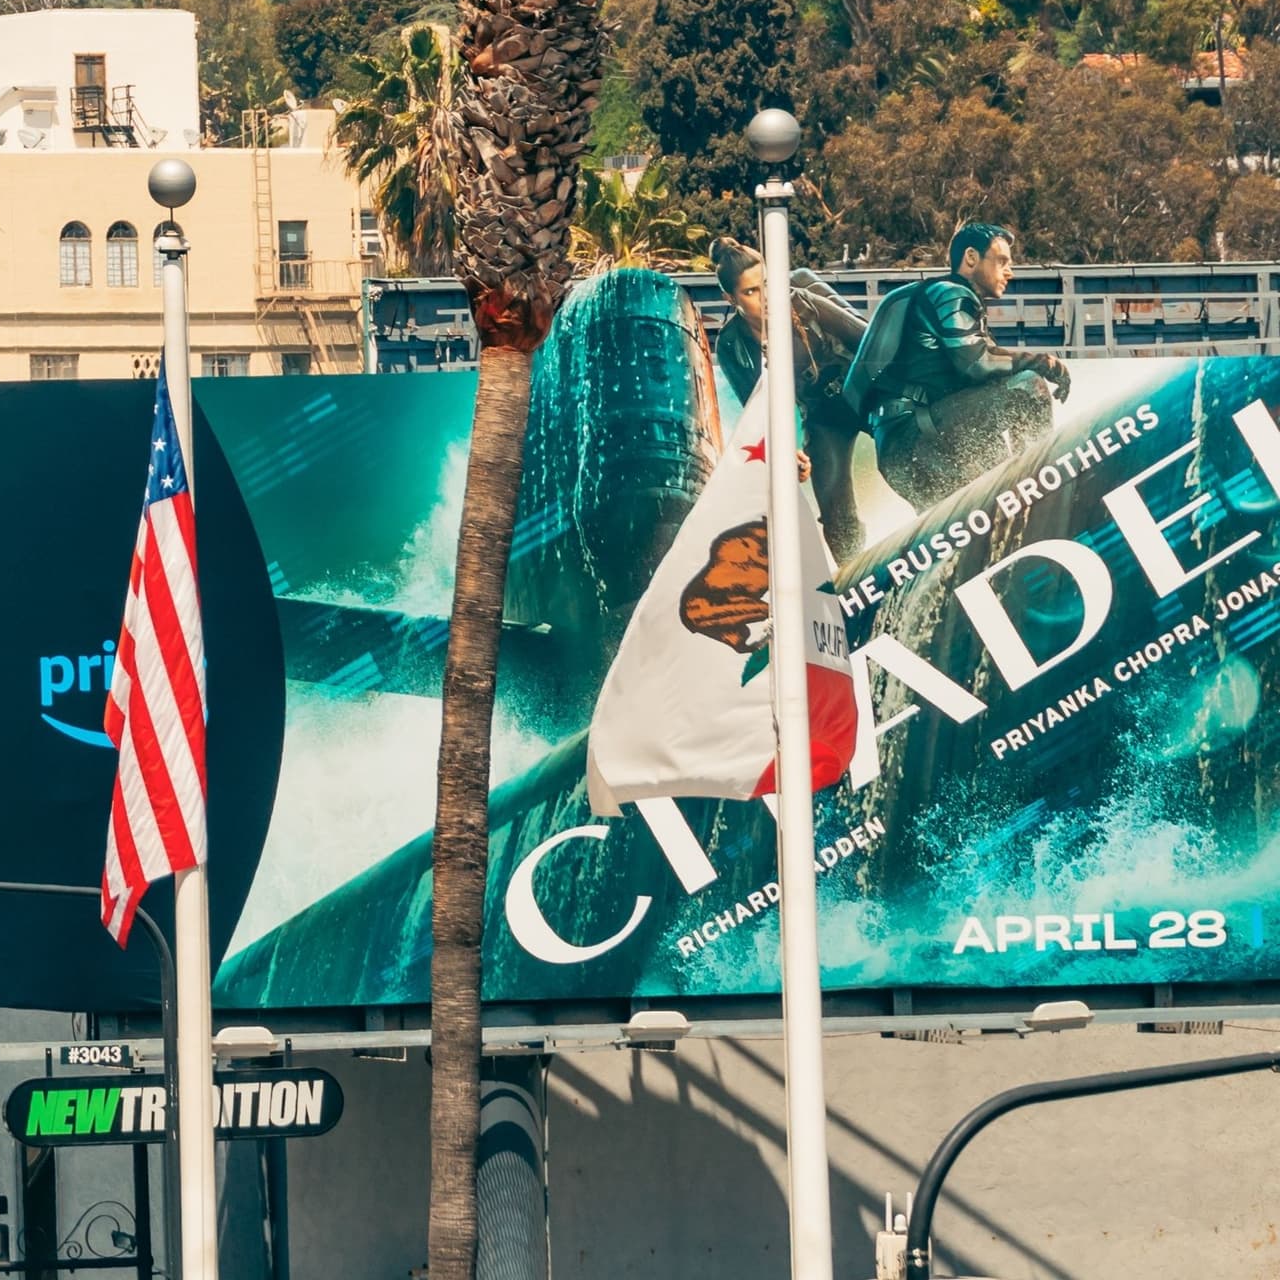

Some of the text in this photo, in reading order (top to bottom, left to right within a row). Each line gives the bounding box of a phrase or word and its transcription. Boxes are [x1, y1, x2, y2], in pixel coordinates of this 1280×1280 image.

[838, 404, 1160, 617] HE RUSSO BROTHERS
[40, 640, 115, 707] pri
[991, 676, 1111, 761] PRIYANKA
[1114, 614, 1211, 683] CHOPRA
[676, 881, 781, 959] RICHARD
[953, 910, 1228, 954] APRIL 28
[68, 1046, 122, 1064] #3043
